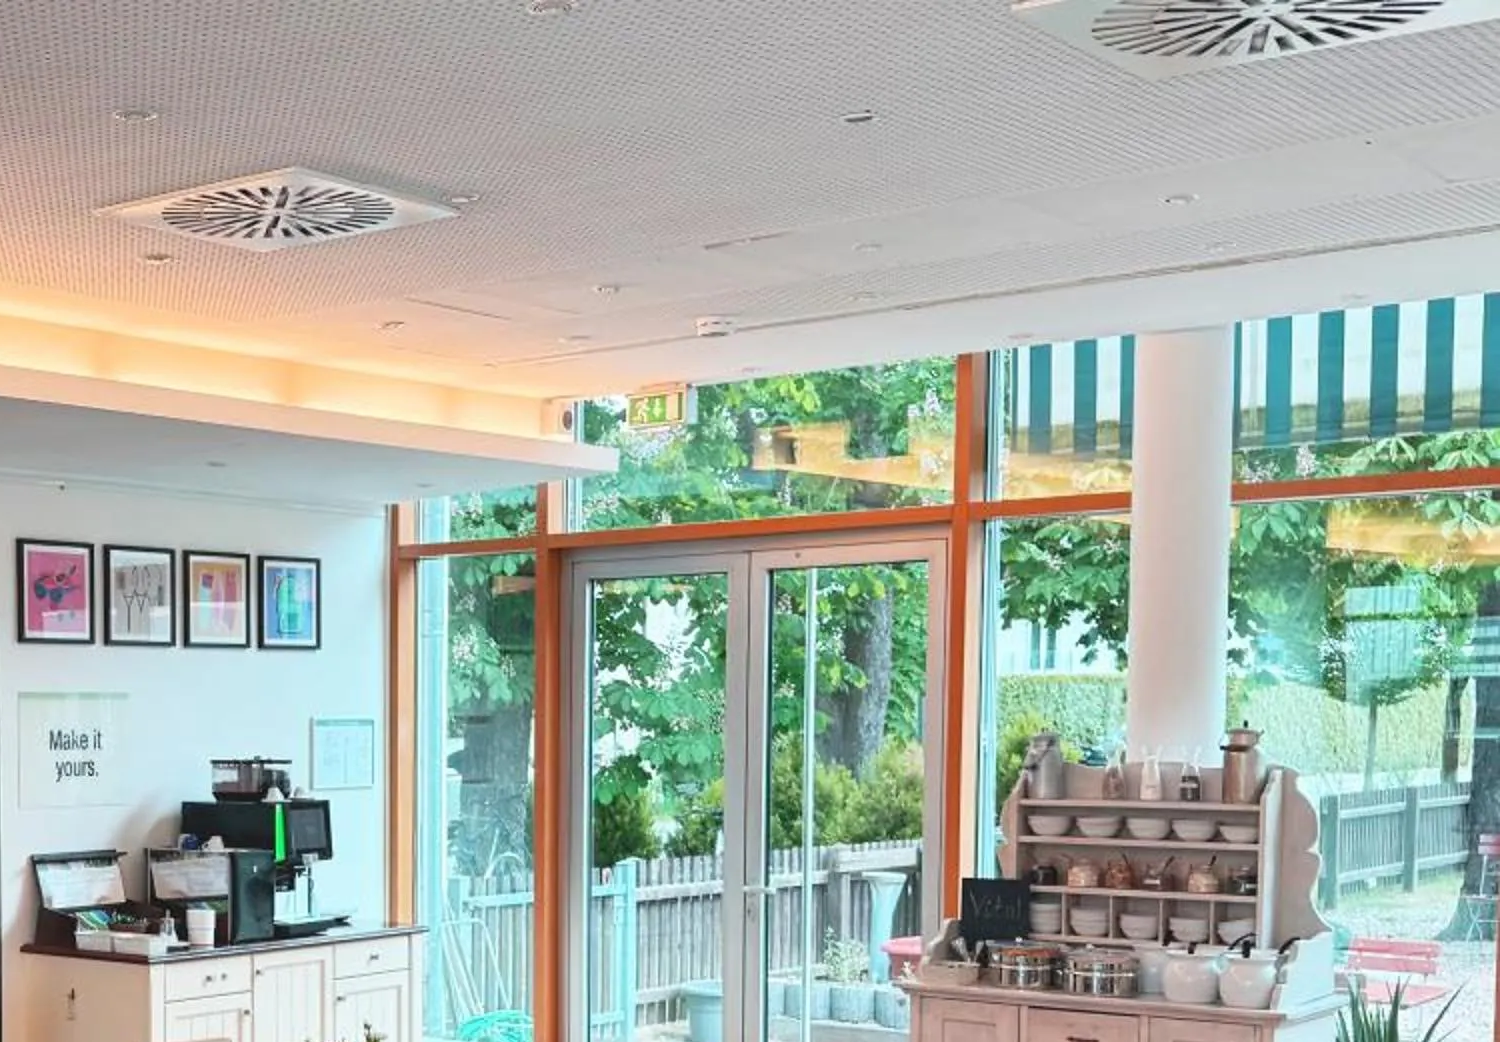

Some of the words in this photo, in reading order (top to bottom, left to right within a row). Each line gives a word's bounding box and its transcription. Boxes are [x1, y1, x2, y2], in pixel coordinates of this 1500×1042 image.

[49, 729, 89, 751] Make
[92, 728, 102, 750] it
[55, 760, 99, 782] yours.
